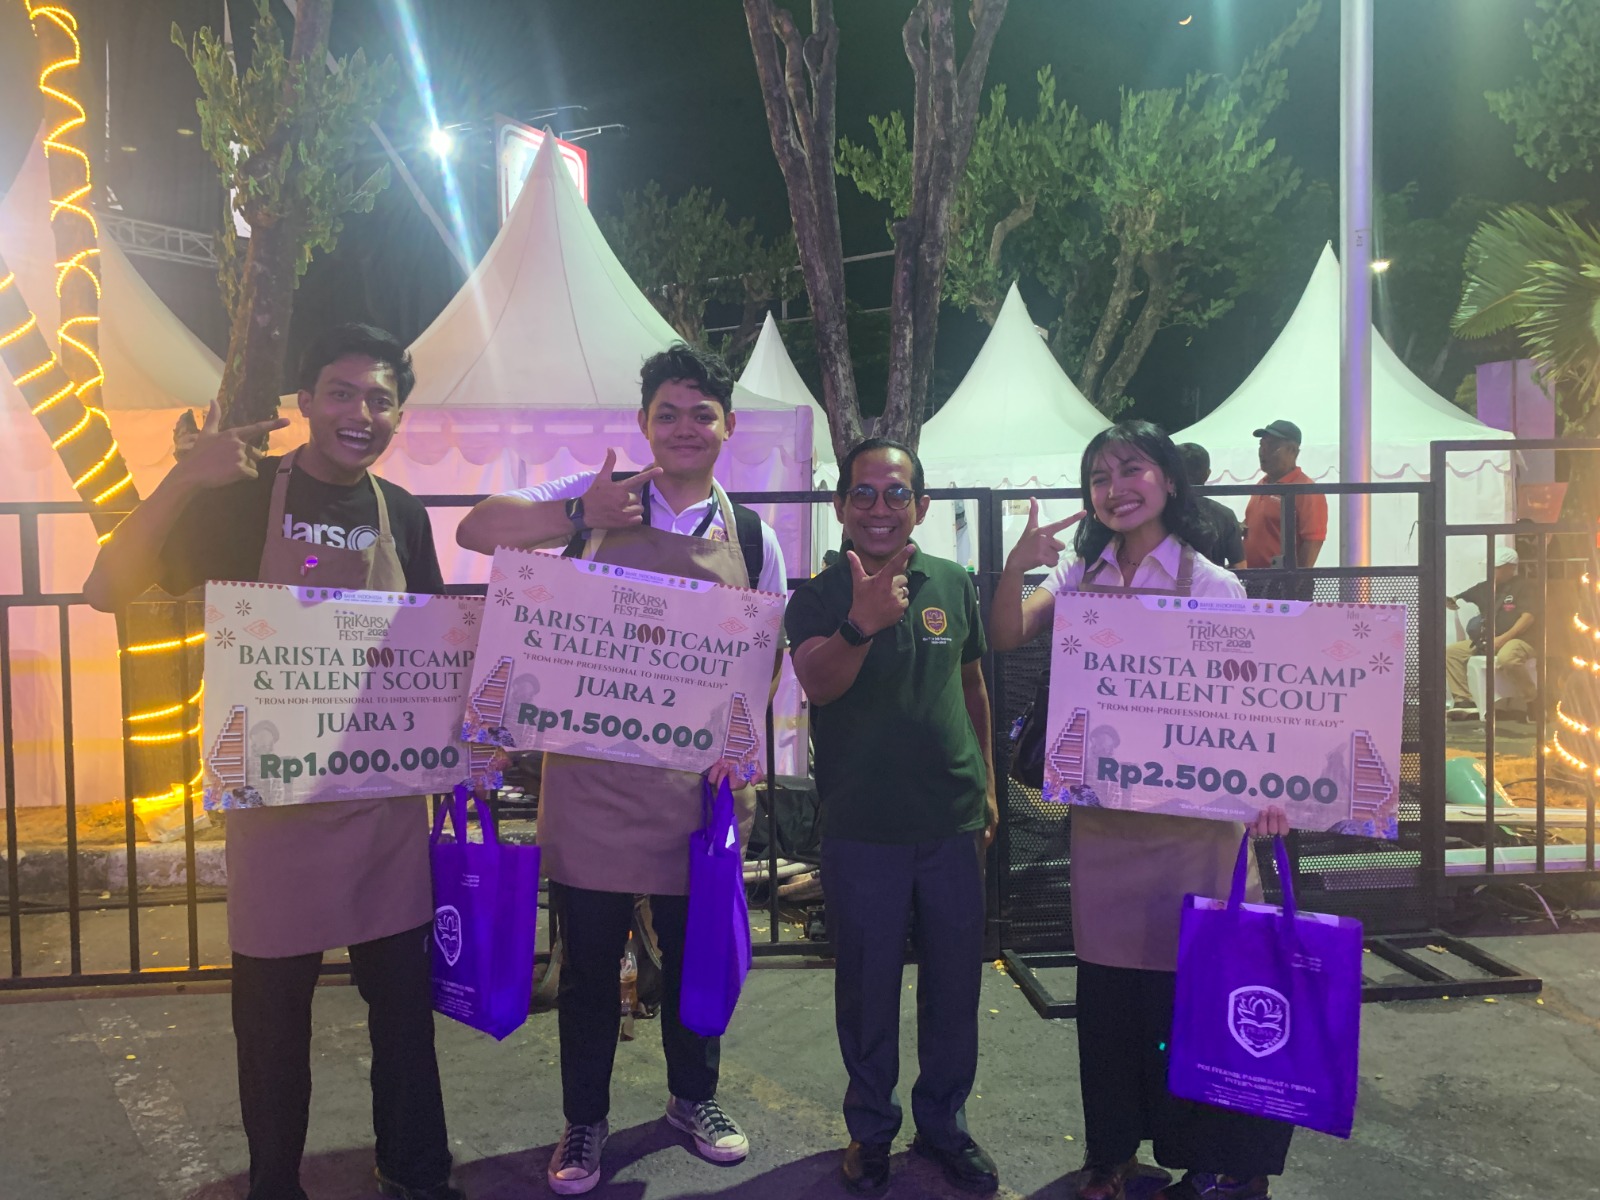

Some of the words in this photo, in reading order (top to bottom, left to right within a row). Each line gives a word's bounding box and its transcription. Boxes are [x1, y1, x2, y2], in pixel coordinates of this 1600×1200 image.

[613, 605, 639, 617] FEST
[339, 630, 364, 640] FEST
[367, 628, 388, 636] 2026
[514, 605, 614, 637] BARISTA
[623, 622, 750, 658] BOOTCAMP
[239, 645, 344, 666] BARISTA
[352, 647, 475, 668] BOOTCAMP
[524, 629, 543, 648] &
[551, 632, 645, 663] TALENT
[648, 648, 734, 677] SCOUT
[1192, 640, 1222, 652] FEST
[253, 670, 275, 690] &
[280, 671, 377, 690] TALENT
[382, 671, 463, 690] SCOUT
[553, 658, 637, 676] NON-PROFESSIONAL
[641, 670, 652, 679] TO
[1084, 652, 1197, 677] BARISTA
[1206, 658, 1366, 688] BOOTCAMP
[287, 696, 374, 705] NON-PROFESSIONAL
[574, 675, 655, 705] JUARA
[661, 688, 676, 707] 2
[1097, 676, 1118, 697] &
[1124, 678, 1235, 705] TALENT
[1241, 686, 1348, 713] SCOUT
[317, 712, 397, 738] JUARA
[402, 711, 415, 732] 3
[517, 702, 713, 750] Rp1.500.000
[1131, 705, 1230, 720] NON-PROFESSIONAL
[1232, 712, 1247, 721] TO
[1163, 723, 1259, 753] JUARA
[1267, 732, 1276, 753] 1
[260, 746, 459, 783] Rp1.000.000
[1097, 757, 1338, 804] Rp2.500.000
